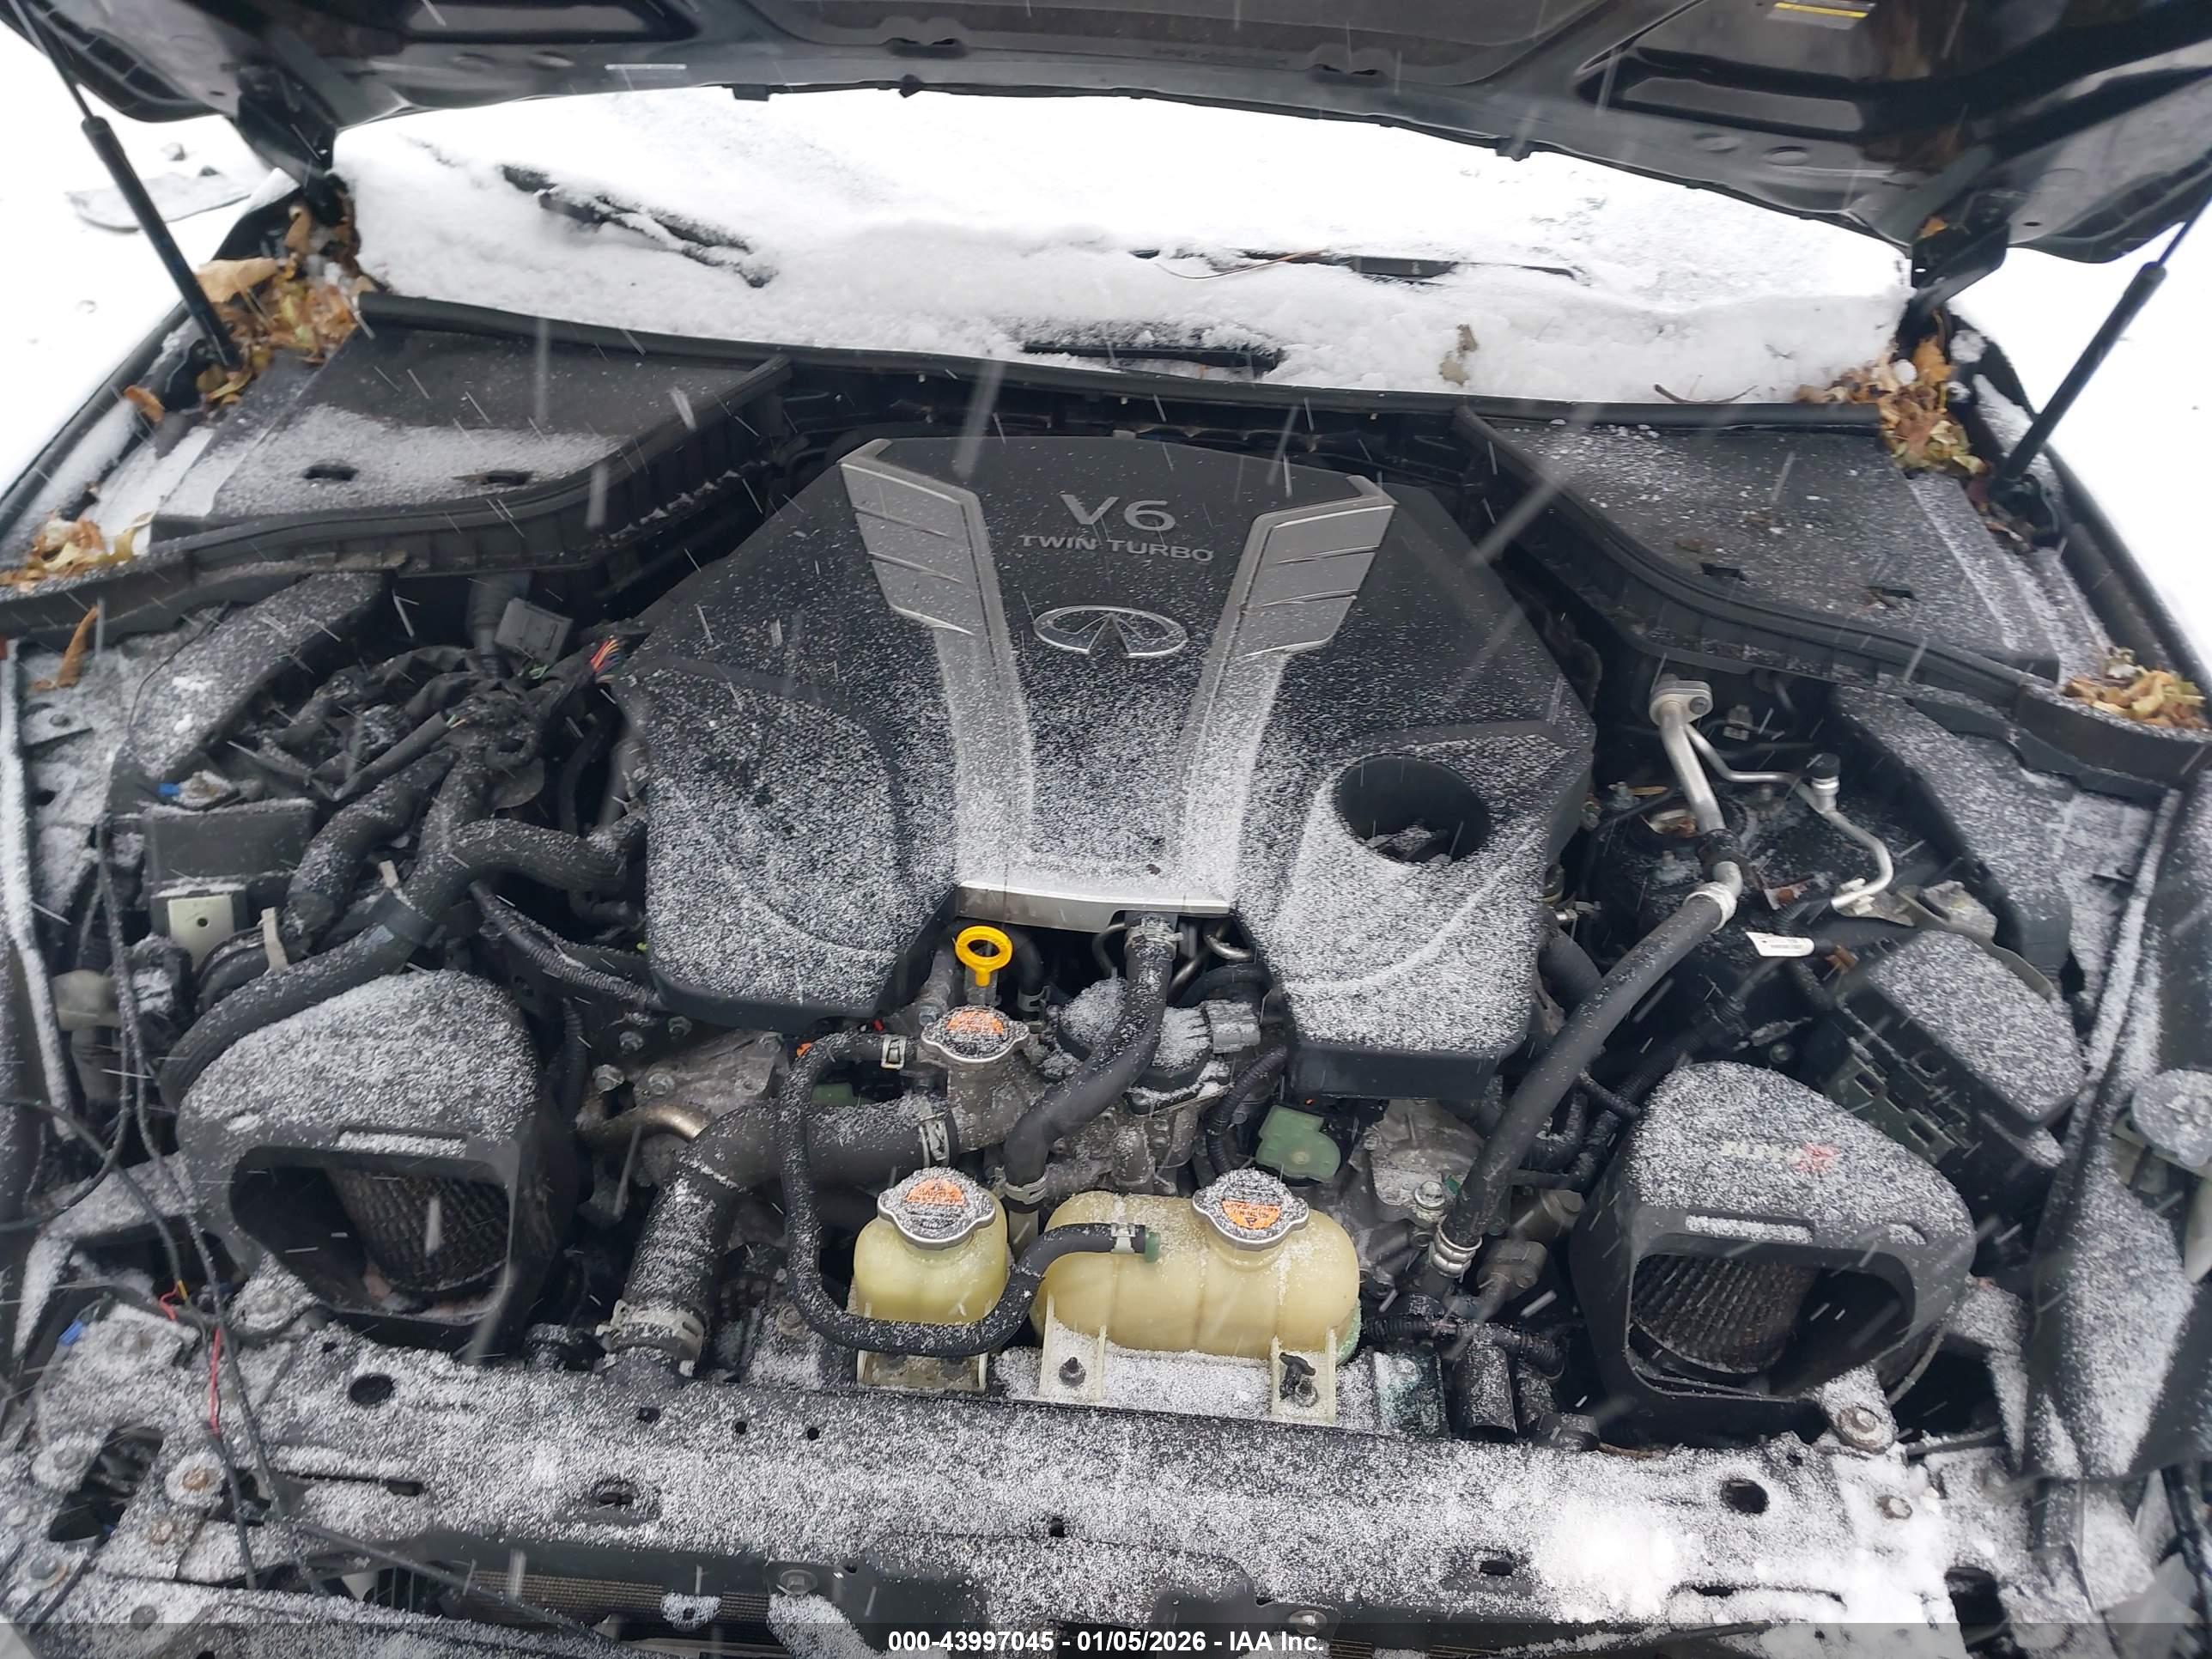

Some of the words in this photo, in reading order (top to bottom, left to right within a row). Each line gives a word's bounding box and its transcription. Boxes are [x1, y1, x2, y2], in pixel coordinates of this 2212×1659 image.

[1060, 494, 1176, 532] V6
[1018, 535, 1097, 551] TWIN
[1106, 538, 1215, 562] TURBO
